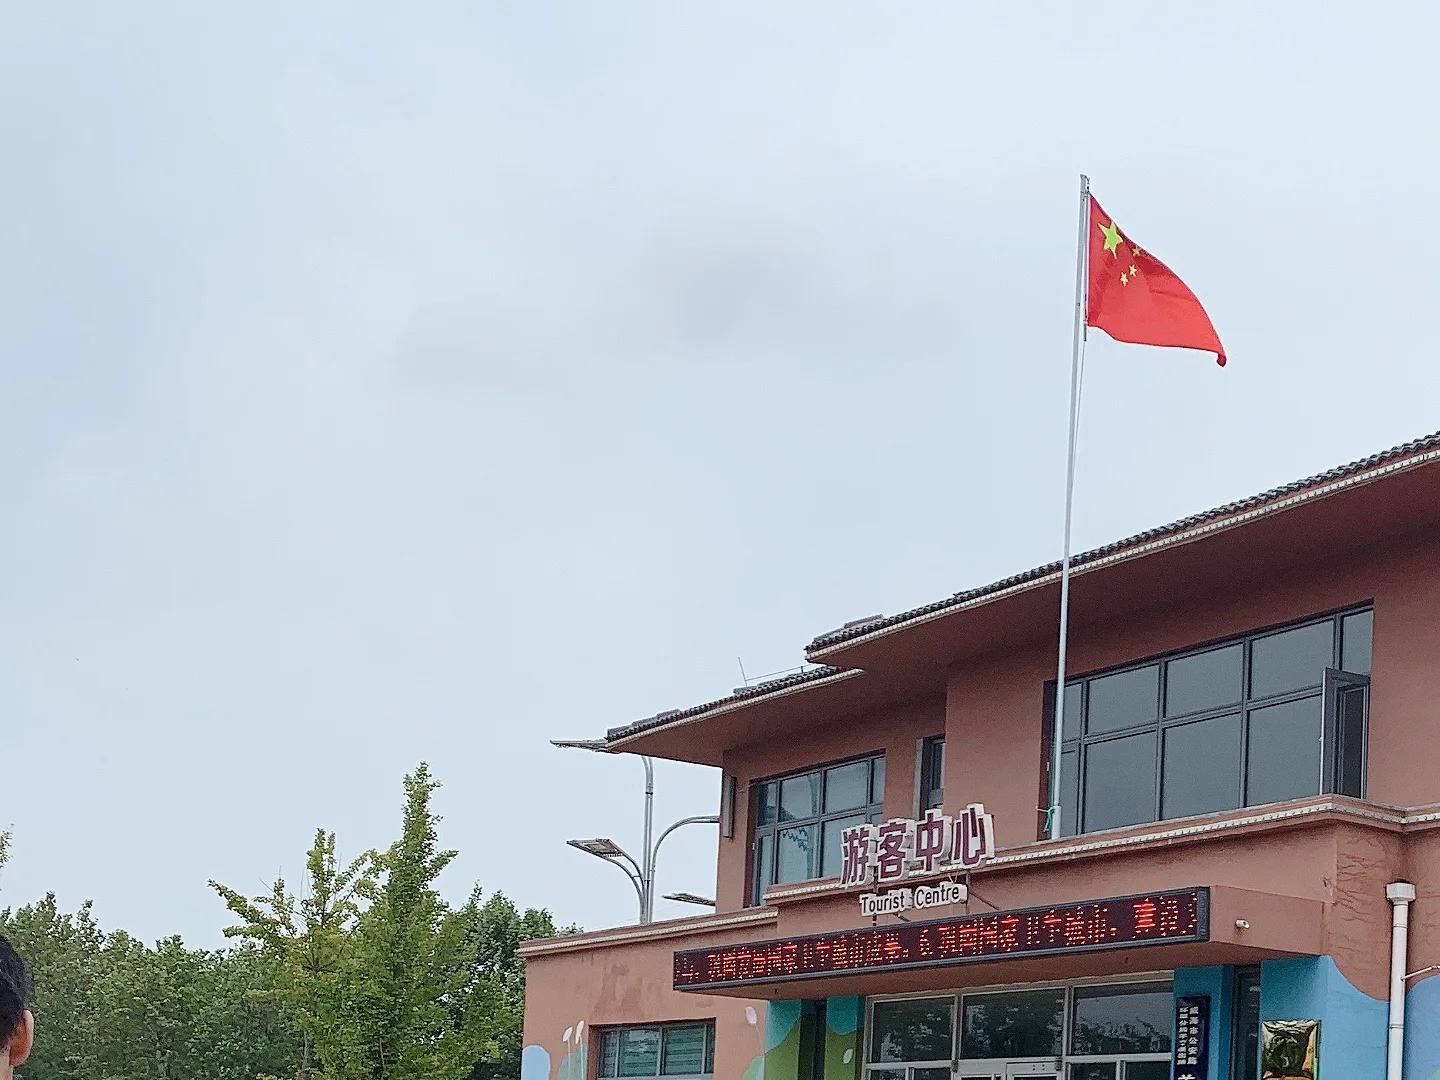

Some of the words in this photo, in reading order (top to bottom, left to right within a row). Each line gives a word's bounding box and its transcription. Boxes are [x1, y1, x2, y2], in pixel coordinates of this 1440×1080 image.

[841, 804, 990, 886] 游客中心
[862, 891, 905, 914] Tourist
[915, 884, 960, 908] Centre
